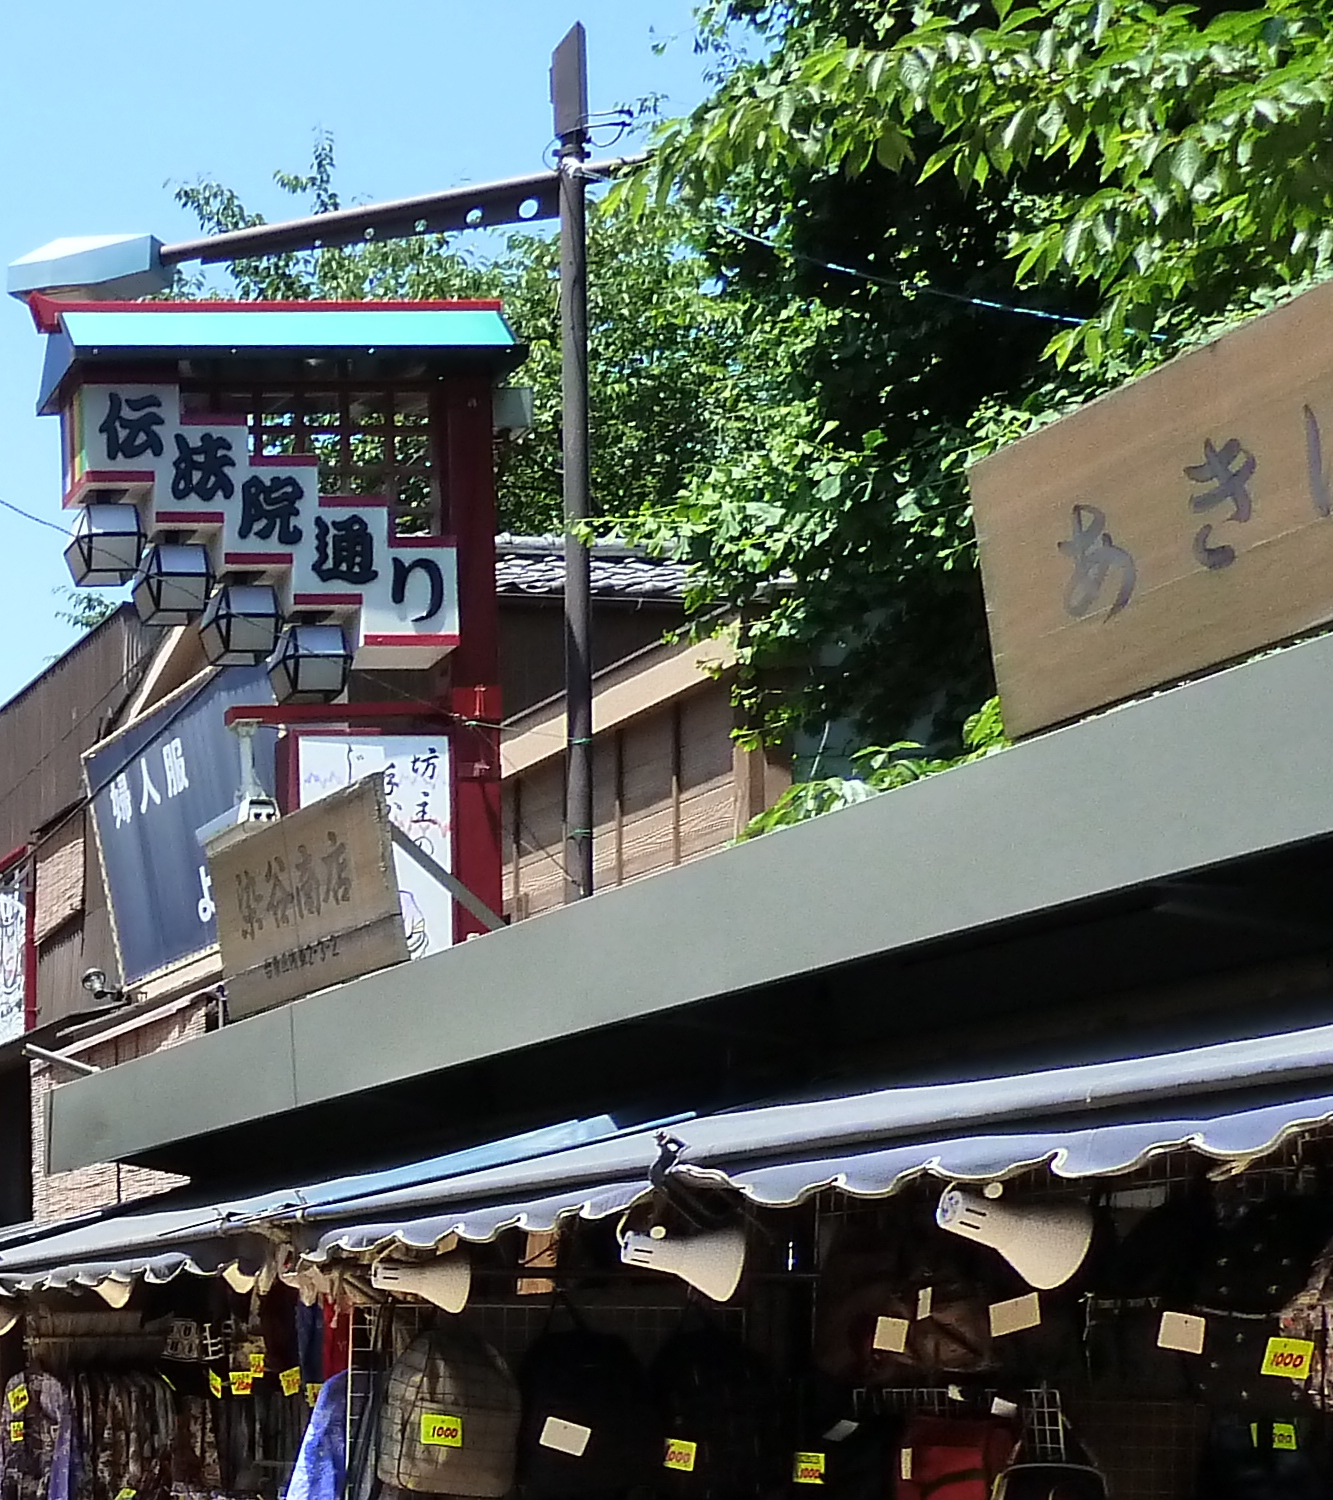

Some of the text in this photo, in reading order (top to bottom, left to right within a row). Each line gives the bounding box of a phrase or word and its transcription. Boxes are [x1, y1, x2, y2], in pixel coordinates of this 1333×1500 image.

[99, 391, 444, 623] 伝法院通り
[109, 736, 191, 830] 婦人服
[1271, 1353, 1304, 1368] 1000
[430, 1426, 459, 1440] 1000
